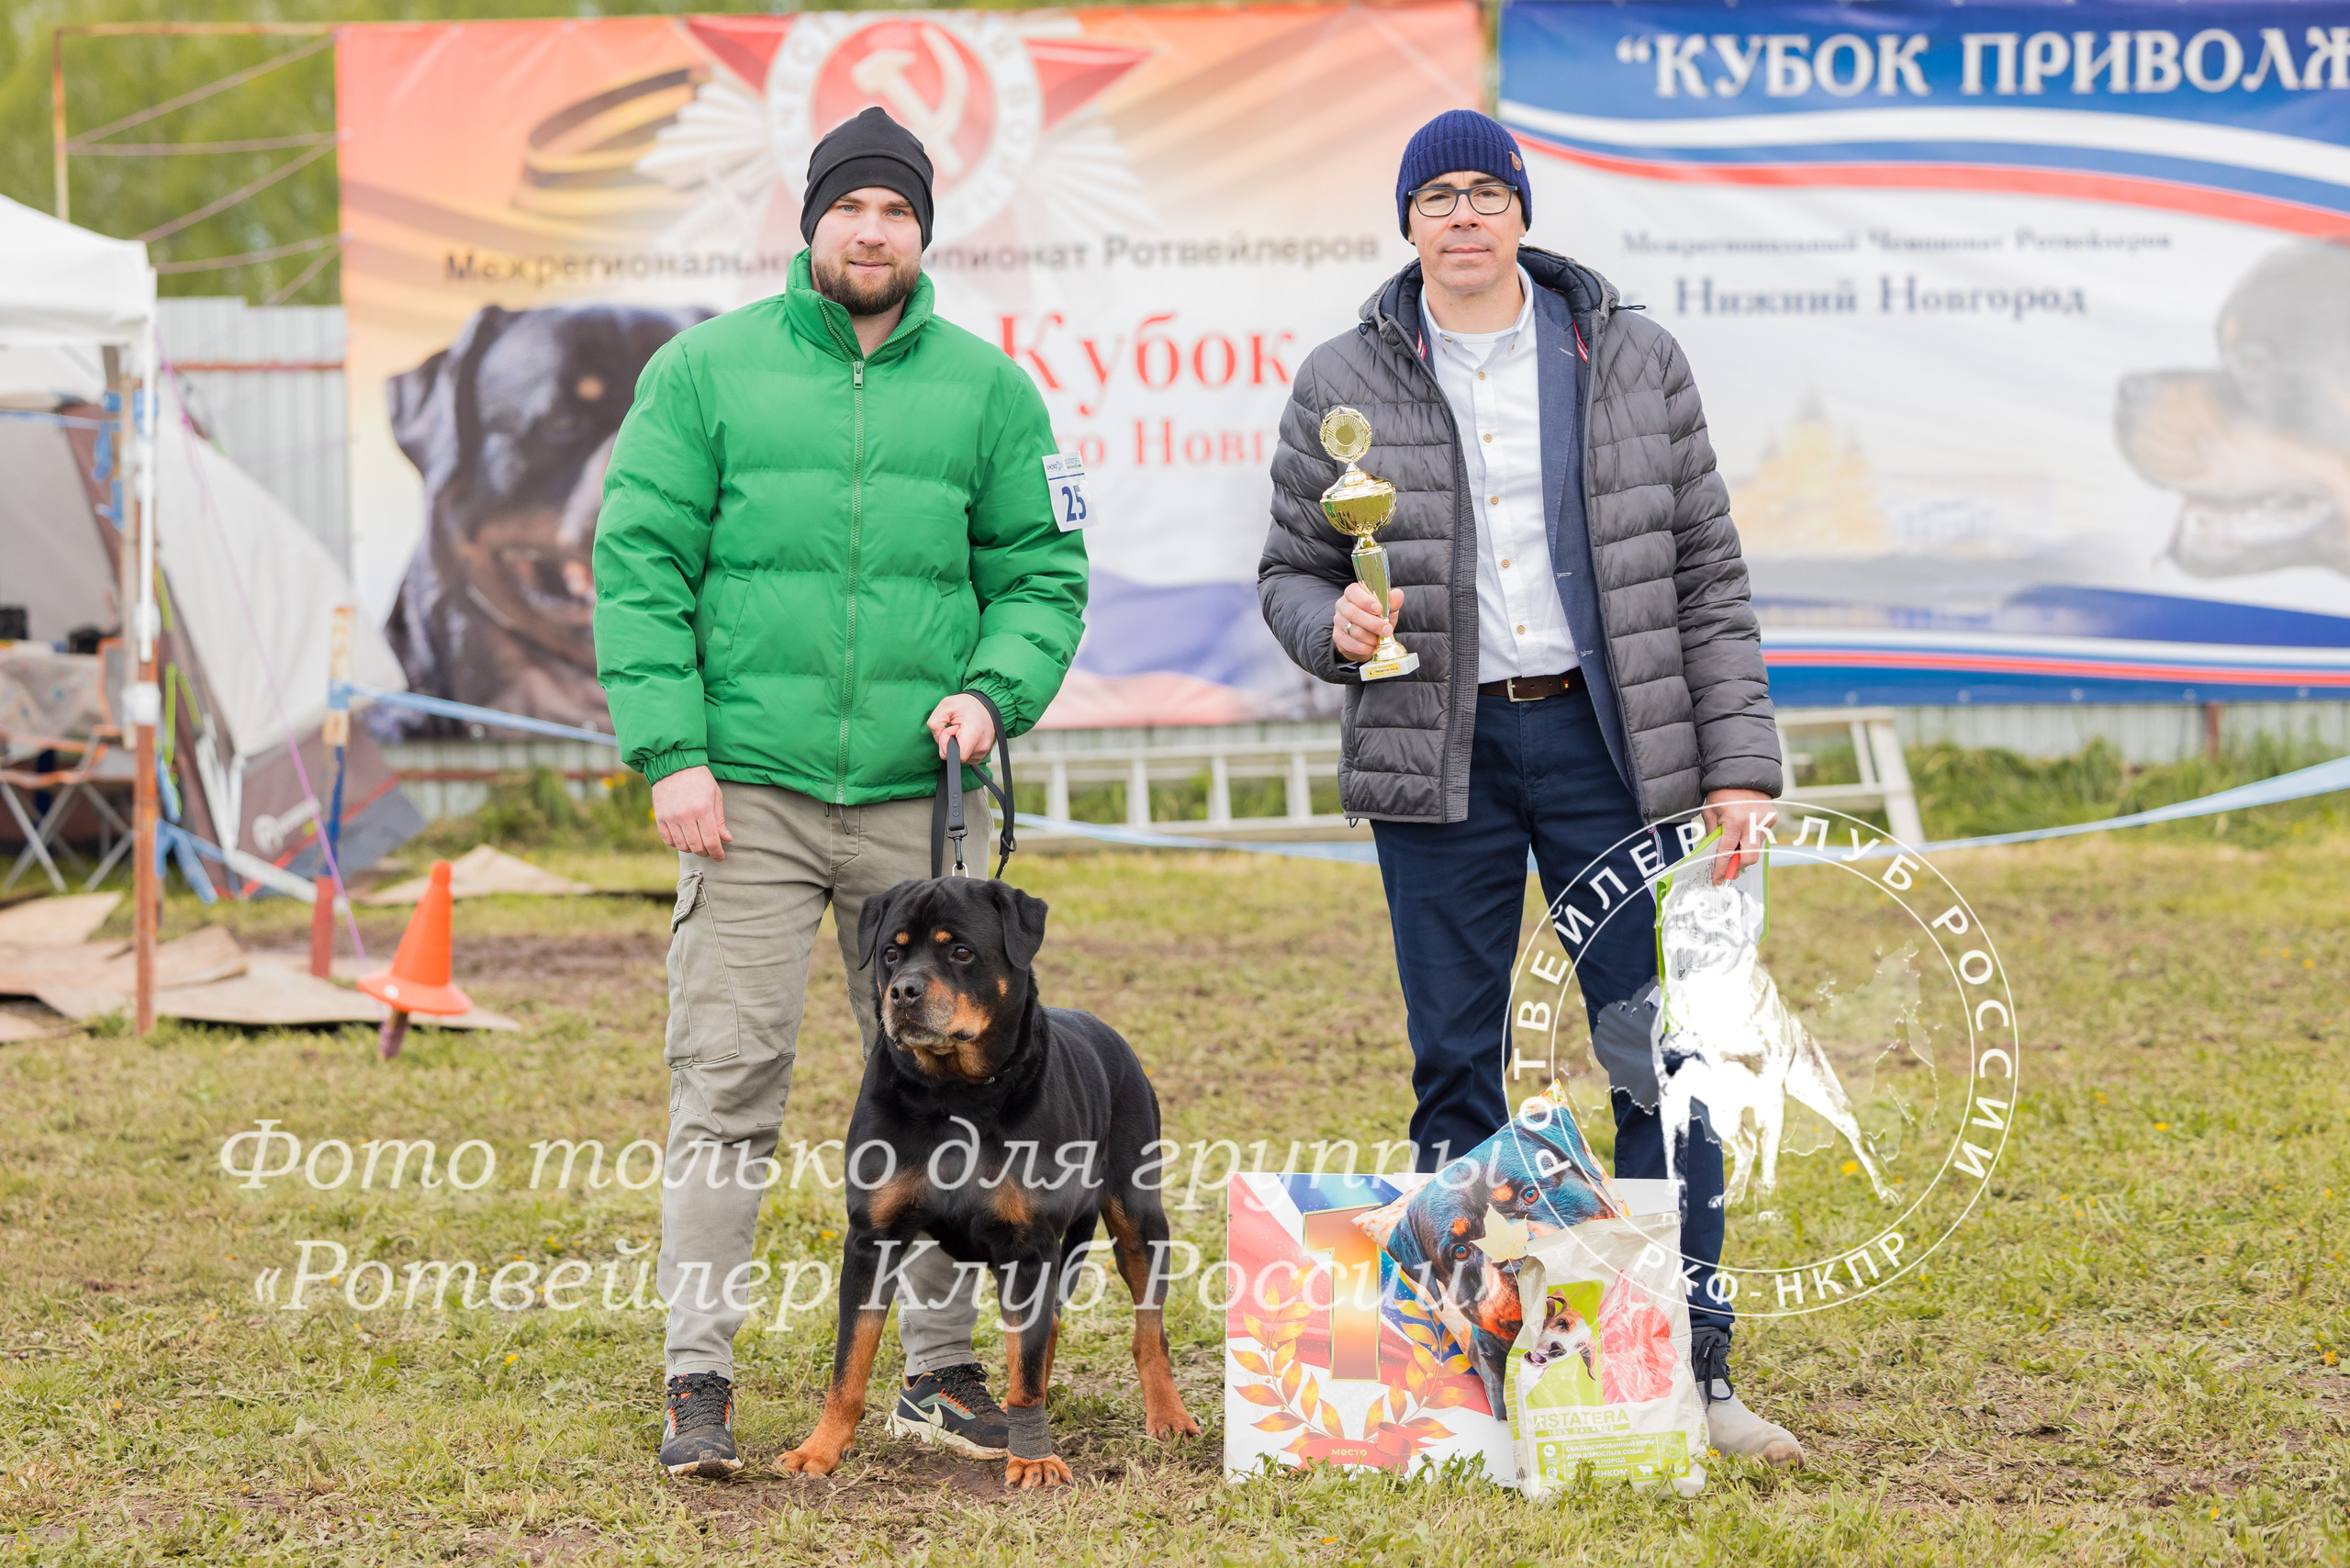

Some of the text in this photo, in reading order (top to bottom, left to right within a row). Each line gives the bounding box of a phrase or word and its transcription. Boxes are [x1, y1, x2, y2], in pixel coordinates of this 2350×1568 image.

[1103, 233, 1381, 270] Ротвейлеров
[1676, 274, 1857, 316] Нижний
[1879, 274, 2089, 322] Новгород
[998, 312, 1293, 417] Кубок
[1135, 419, 1280, 465] Новг
[1061, 485, 1087, 522] 25
[1303, 1203, 1382, 1382] 1
[1548, 1408, 1629, 1428] STATERA
[1573, 1425, 1616, 1434] BALANCE
[1566, 1441, 1635, 1452] СБАЛАНСИРОВАННЫЙ
[1583, 1450, 1622, 1459] ВЗРОСЛЫХ
